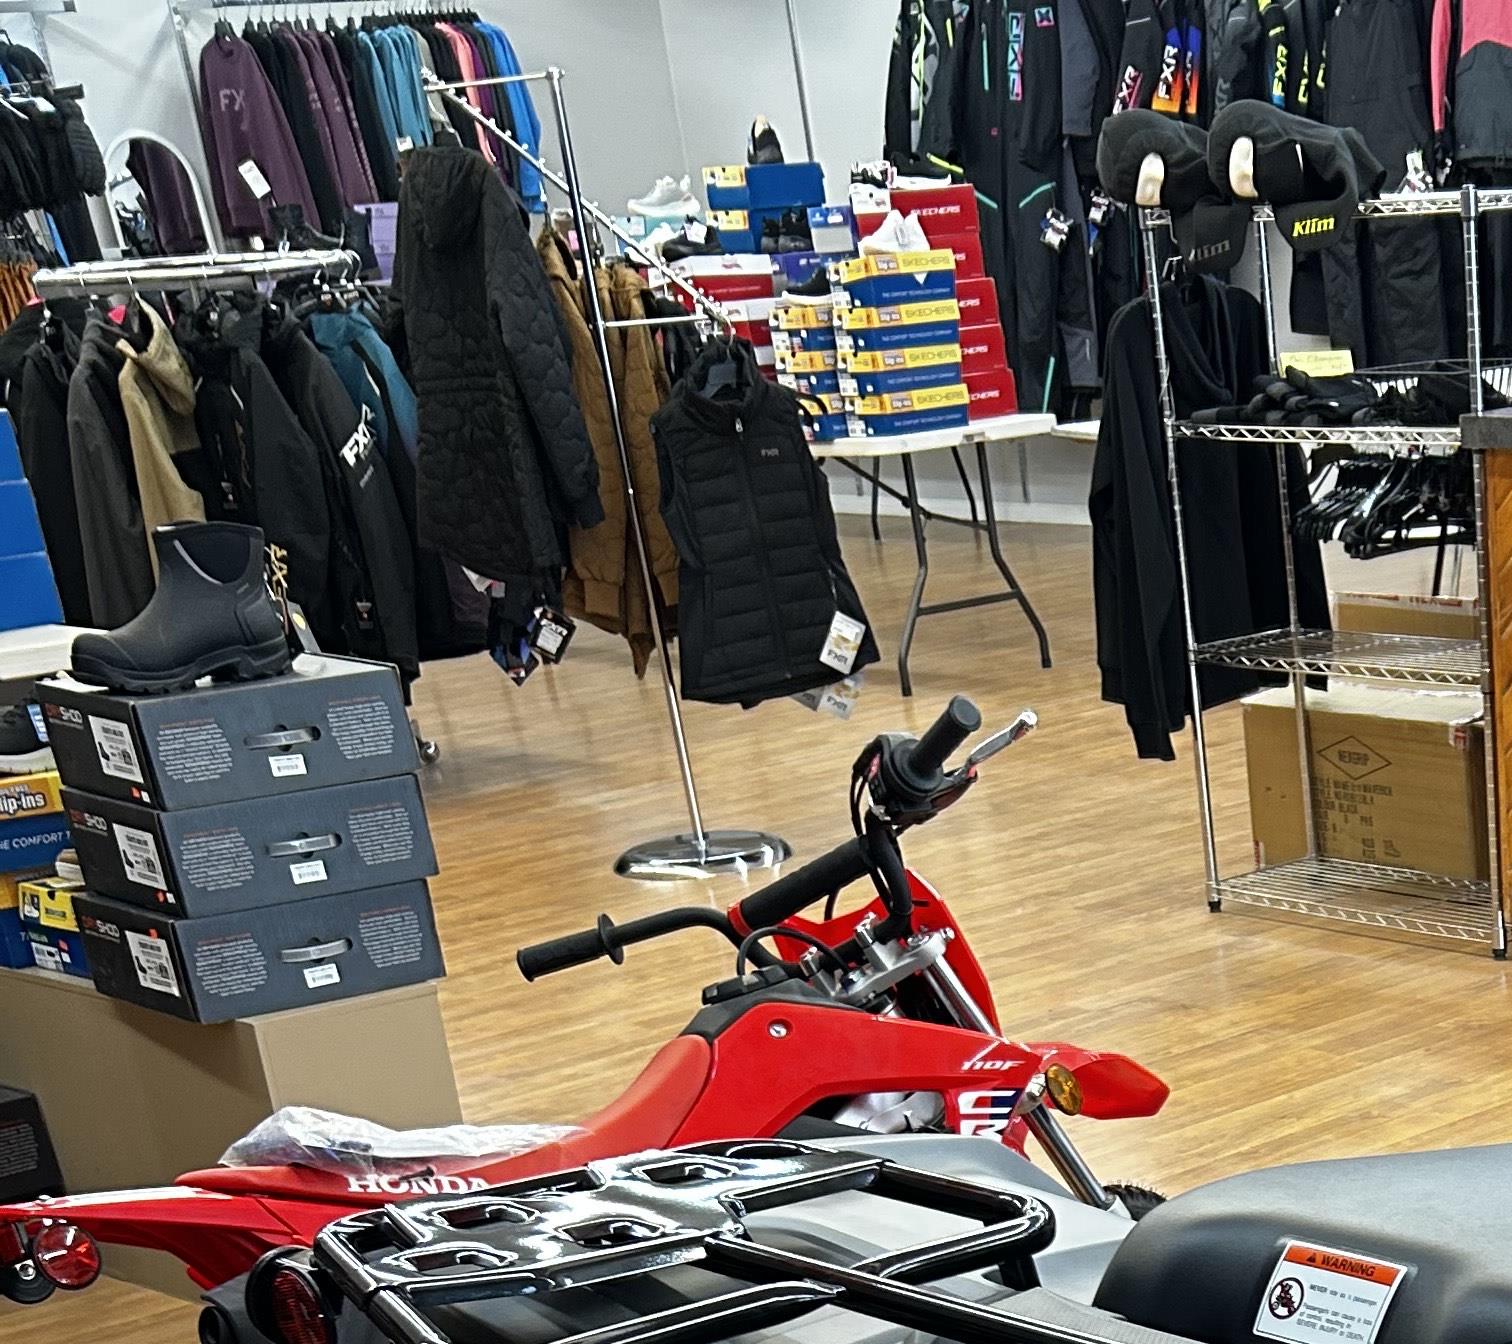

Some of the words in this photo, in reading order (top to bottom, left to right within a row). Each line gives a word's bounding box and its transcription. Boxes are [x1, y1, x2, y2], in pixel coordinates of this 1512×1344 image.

[1157, 44, 1179, 99] FXR
[218, 88, 246, 112] FX
[12, 831, 63, 849] COMFORT
[346, 1174, 490, 1195] HONDA
[1321, 1255, 1376, 1277] WARNING
